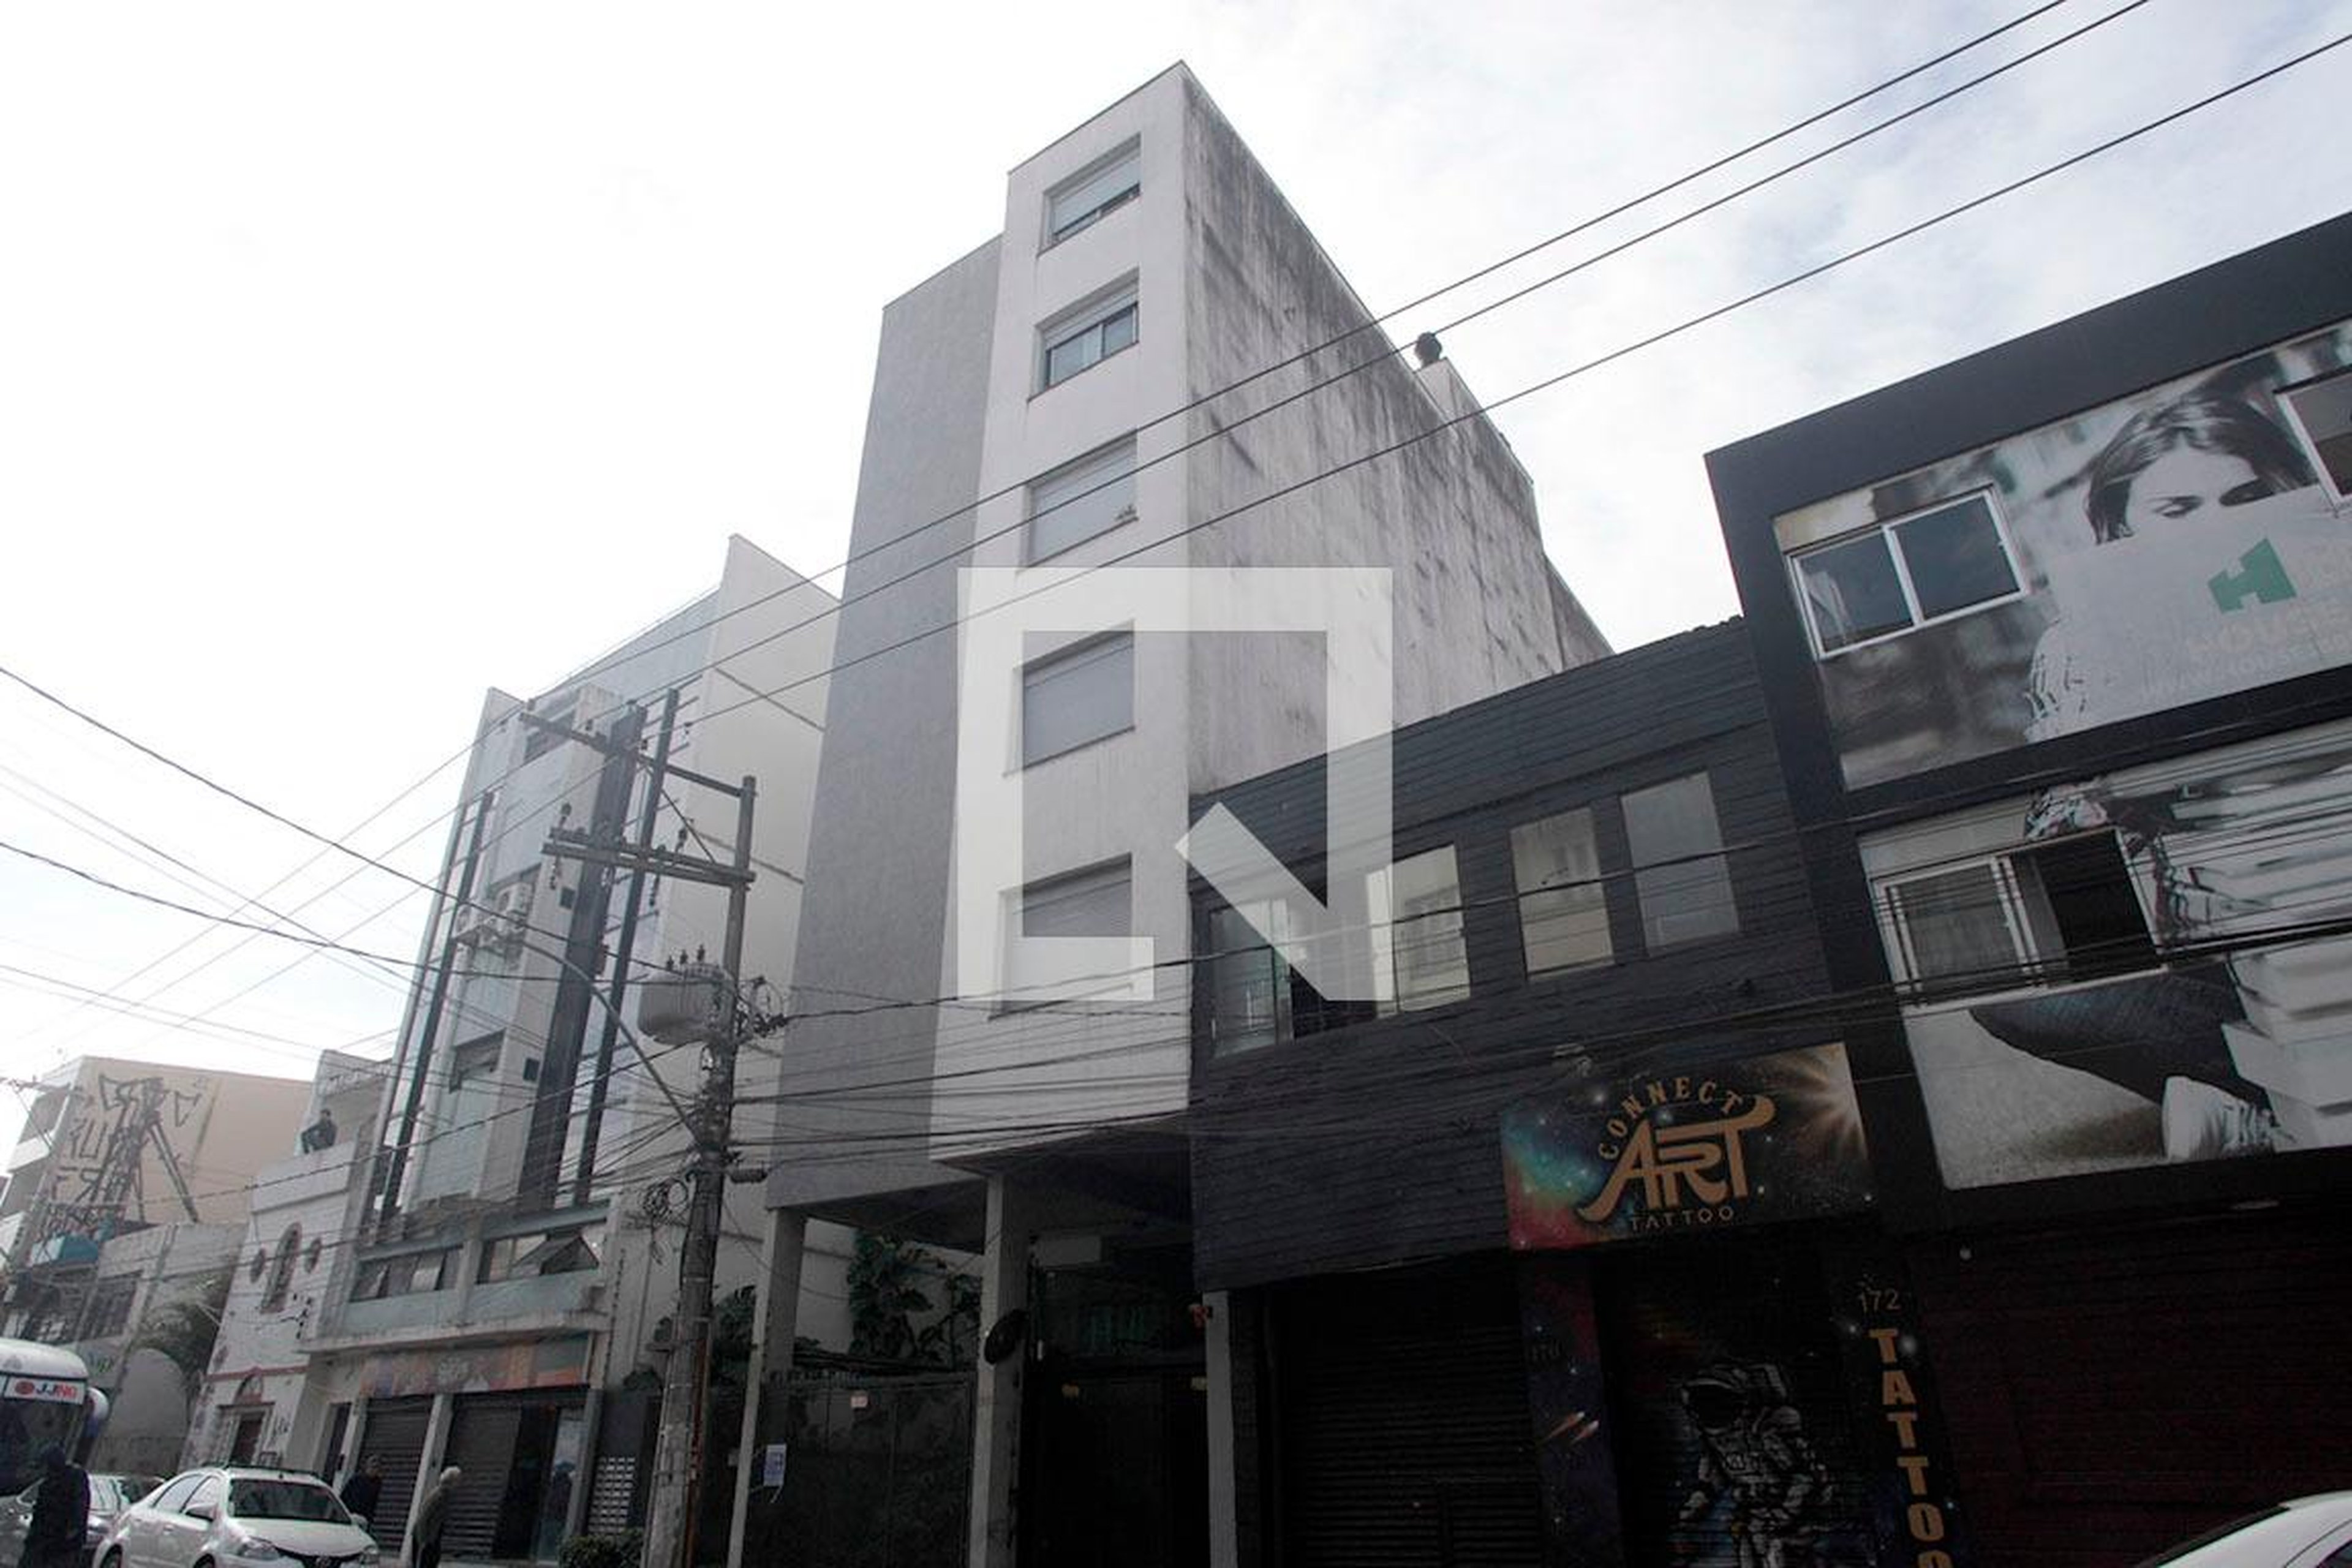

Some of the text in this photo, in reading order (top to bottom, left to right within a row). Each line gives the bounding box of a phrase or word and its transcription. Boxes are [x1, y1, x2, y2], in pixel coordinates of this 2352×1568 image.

[1576, 1095, 1776, 1222] ART
[1598, 1077, 1743, 1160] CONNECT
[1632, 1205, 1734, 1231] TATTOO
